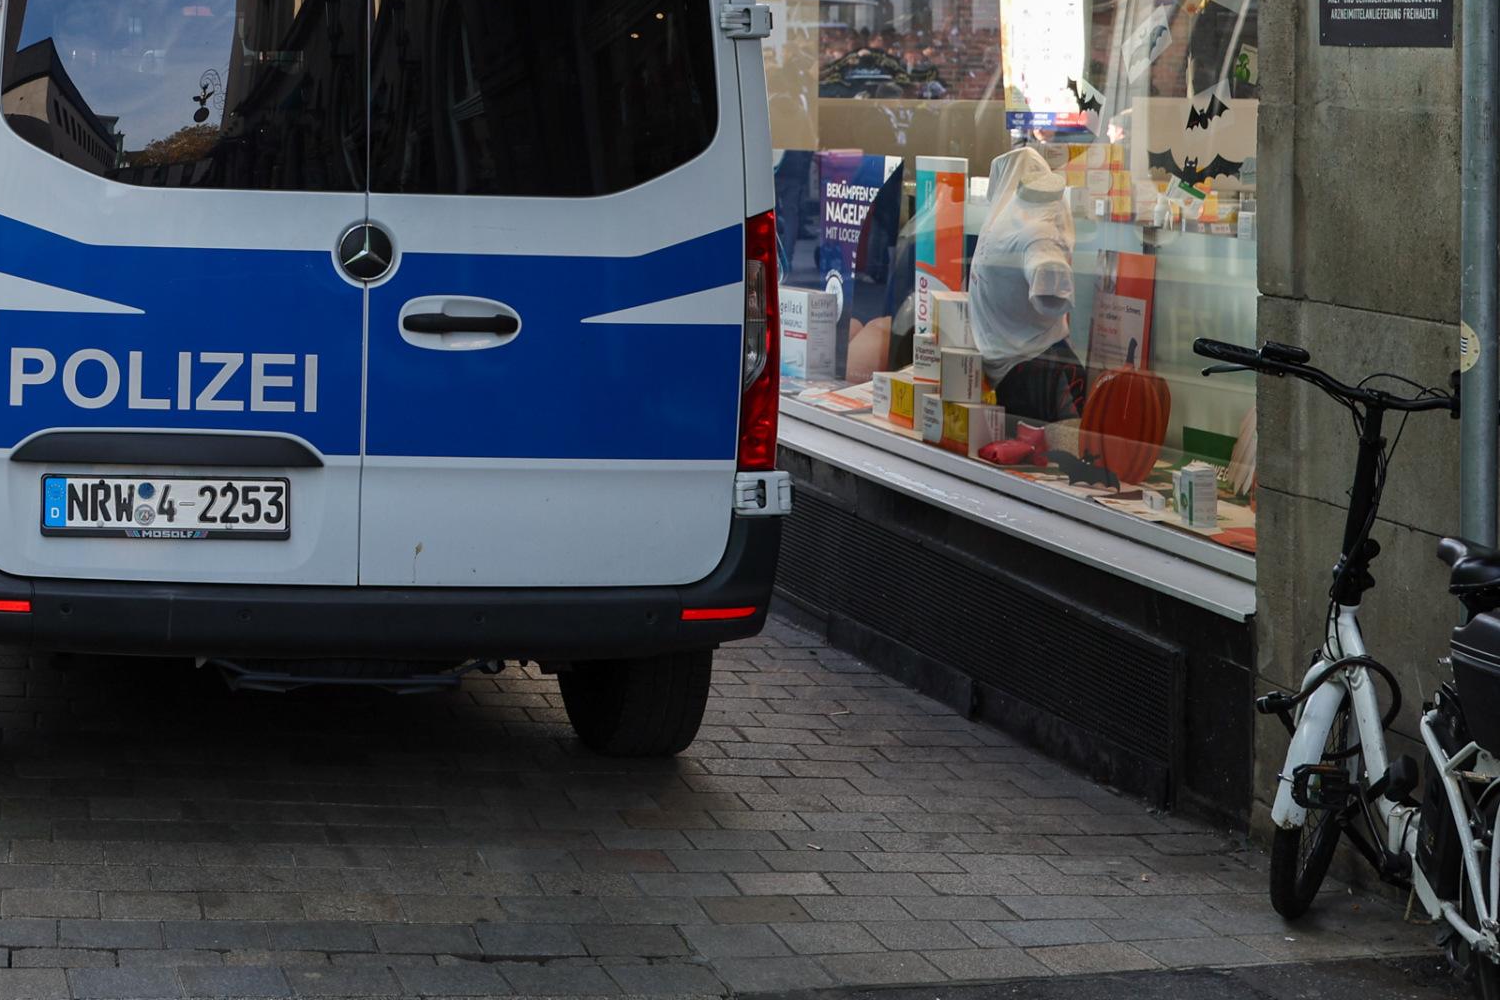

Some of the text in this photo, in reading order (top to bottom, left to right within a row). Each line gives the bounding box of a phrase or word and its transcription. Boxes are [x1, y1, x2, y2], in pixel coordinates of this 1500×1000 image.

[1331, 8, 1402, 20] ARZNEIMITTELANLIEFERUNG
[826, 180, 869, 201] BEKÄMPFEN
[825, 226, 861, 243] MIT LOCER
[918, 276, 929, 322] forte
[9, 347, 318, 413] POLIZEI
[67, 483, 135, 523] NRW
[51, 507, 60, 519] D
[141, 529, 195, 538] MOSOLF
